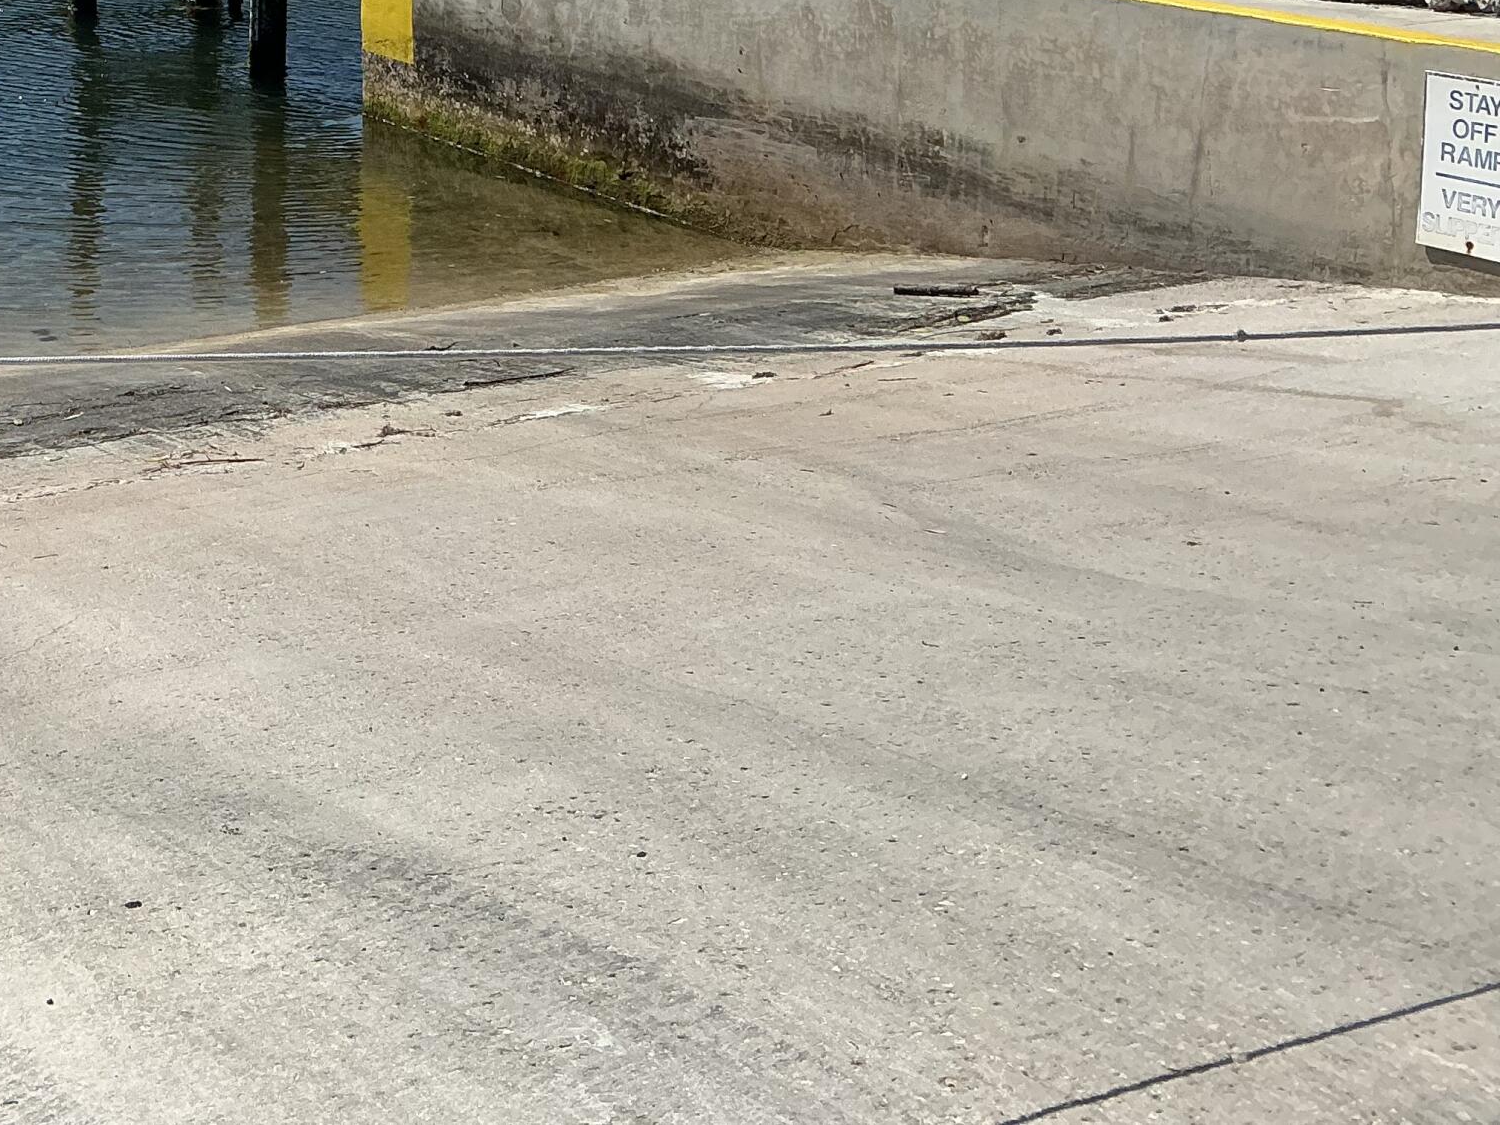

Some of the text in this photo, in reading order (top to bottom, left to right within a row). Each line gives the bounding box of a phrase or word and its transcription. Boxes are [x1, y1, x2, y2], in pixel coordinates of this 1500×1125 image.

[1449, 89, 1500, 117] STAY
[1452, 118, 1498, 143] OFF
[1441, 188, 1500, 219] VERY
